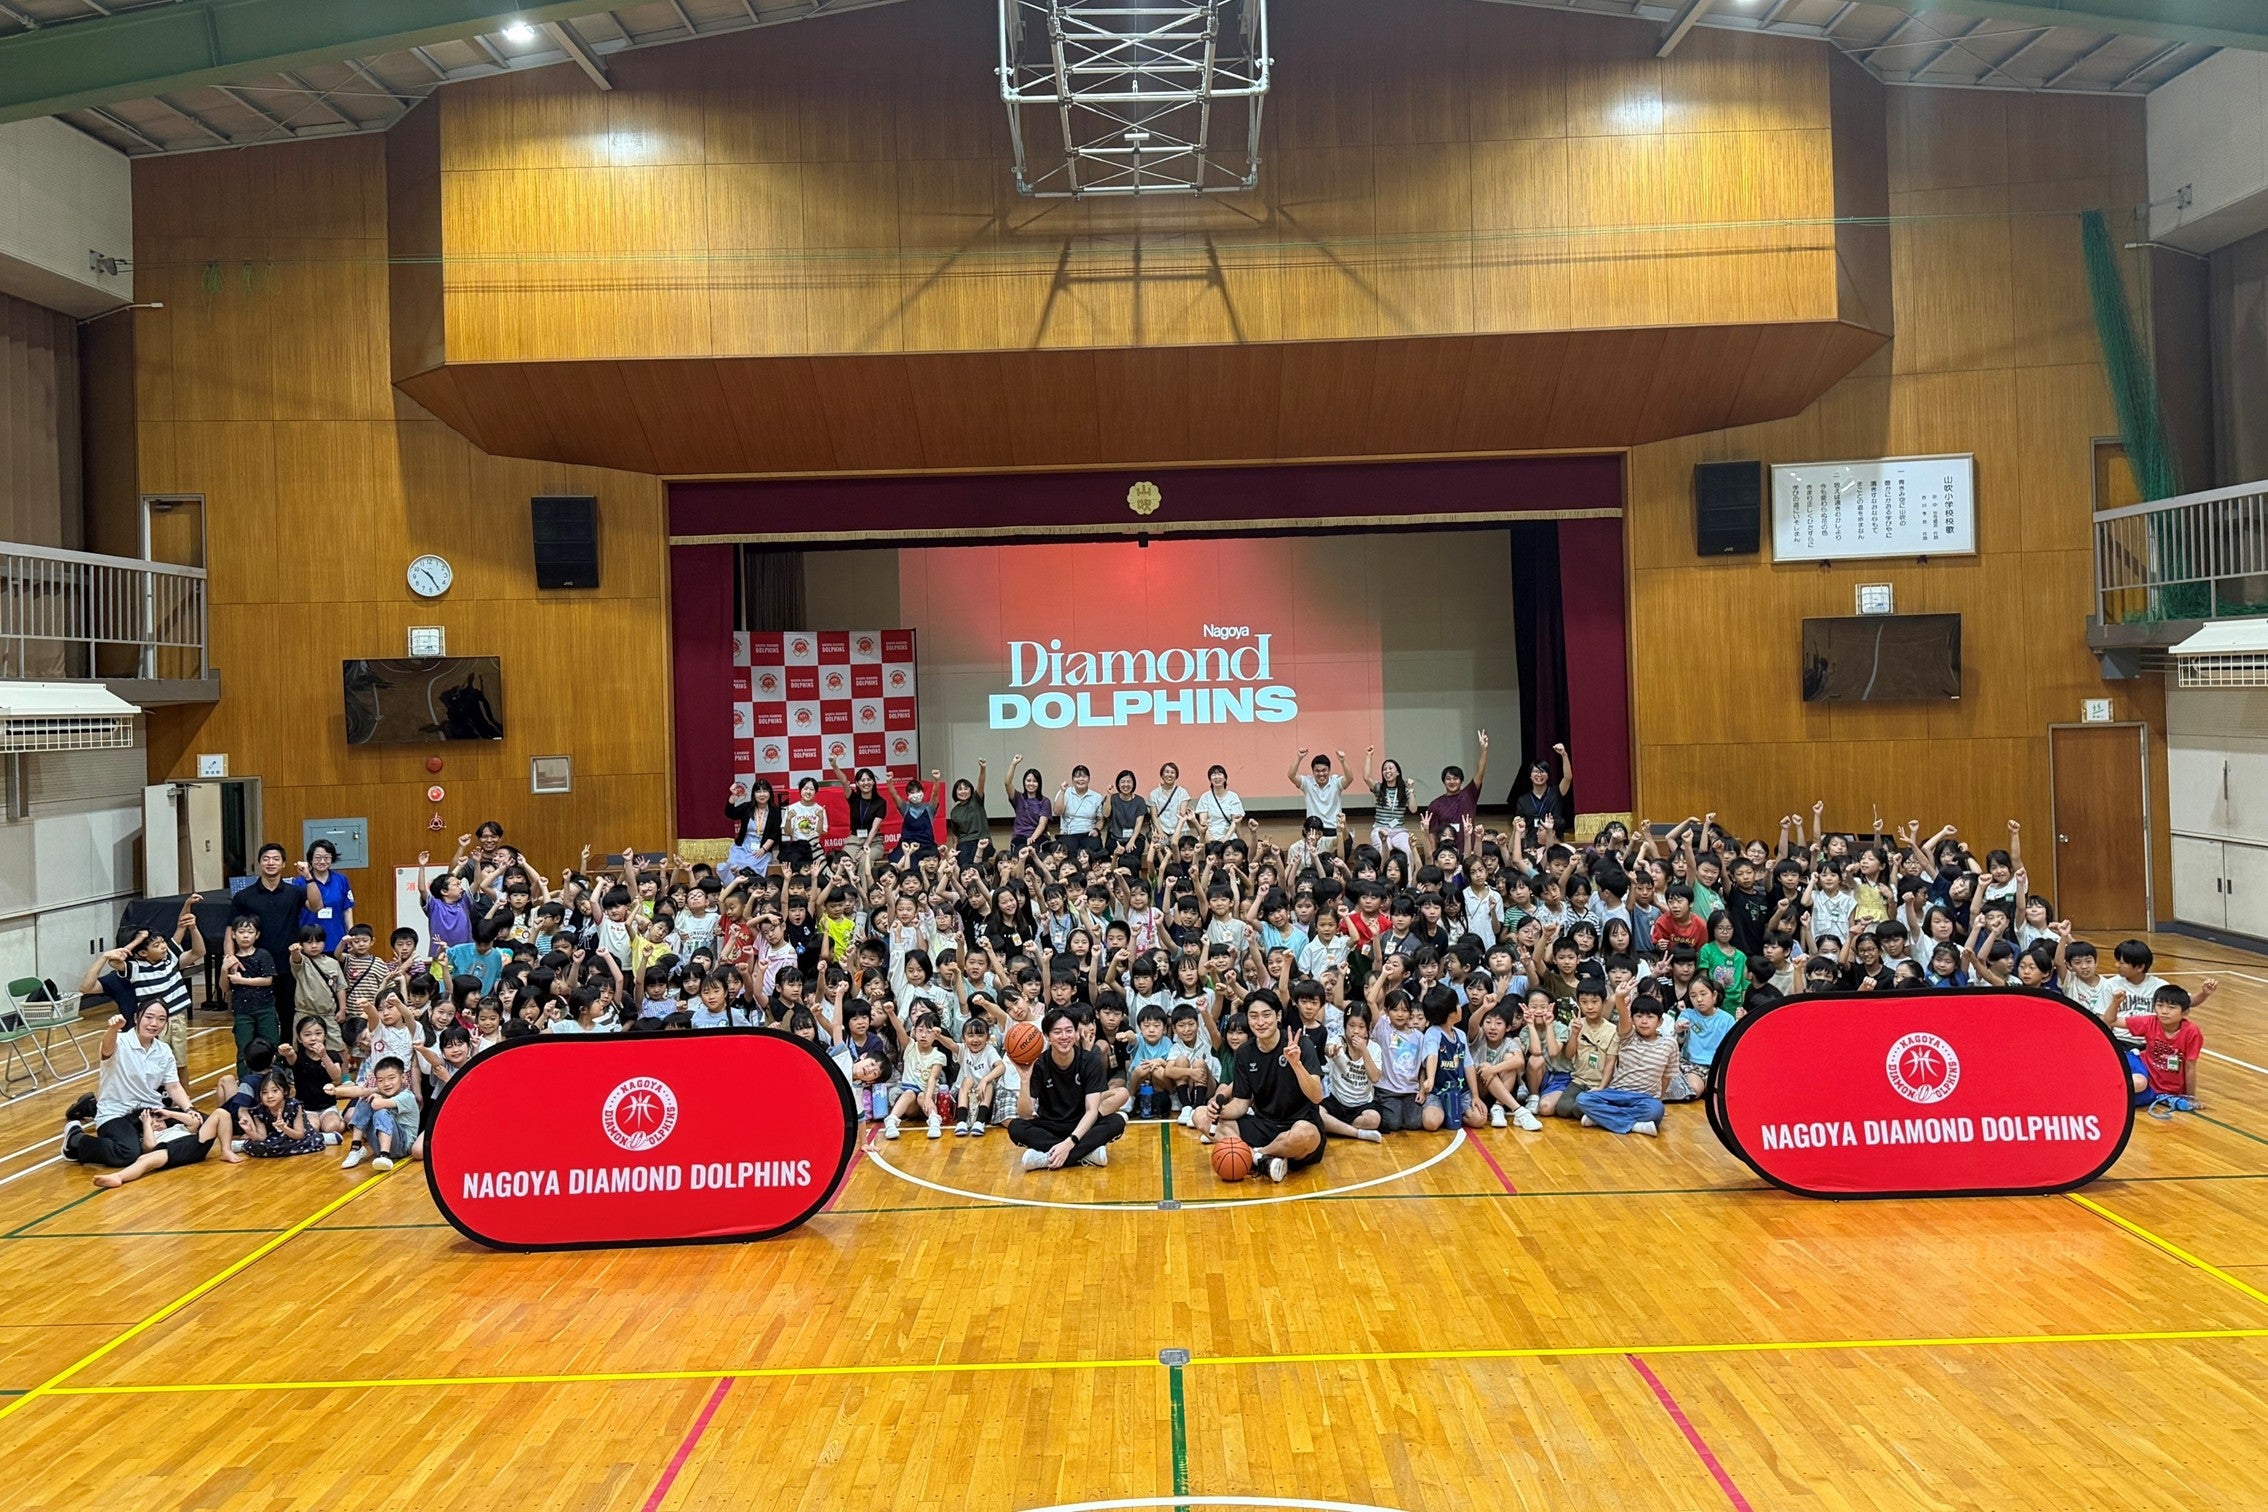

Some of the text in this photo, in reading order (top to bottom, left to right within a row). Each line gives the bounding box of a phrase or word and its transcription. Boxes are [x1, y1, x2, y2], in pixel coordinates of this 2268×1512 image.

[1944, 476, 1954, 534] 山吹小学校校歌
[1203, 624, 1250, 640] Nagoya
[1007, 634, 1273, 687] Diamond
[989, 685, 1298, 729] DOLPHINS
[824, 837, 845, 847] NAGO
[1899, 1035, 1941, 1049] NAGOYA
[620, 1079, 663, 1093] NAGOYA
[1761, 1115, 2101, 1150] NAGOYA DIAMOND DOLPHINS
[463, 1160, 811, 1199] NAGOYA DIAMOND DOLPHINS
